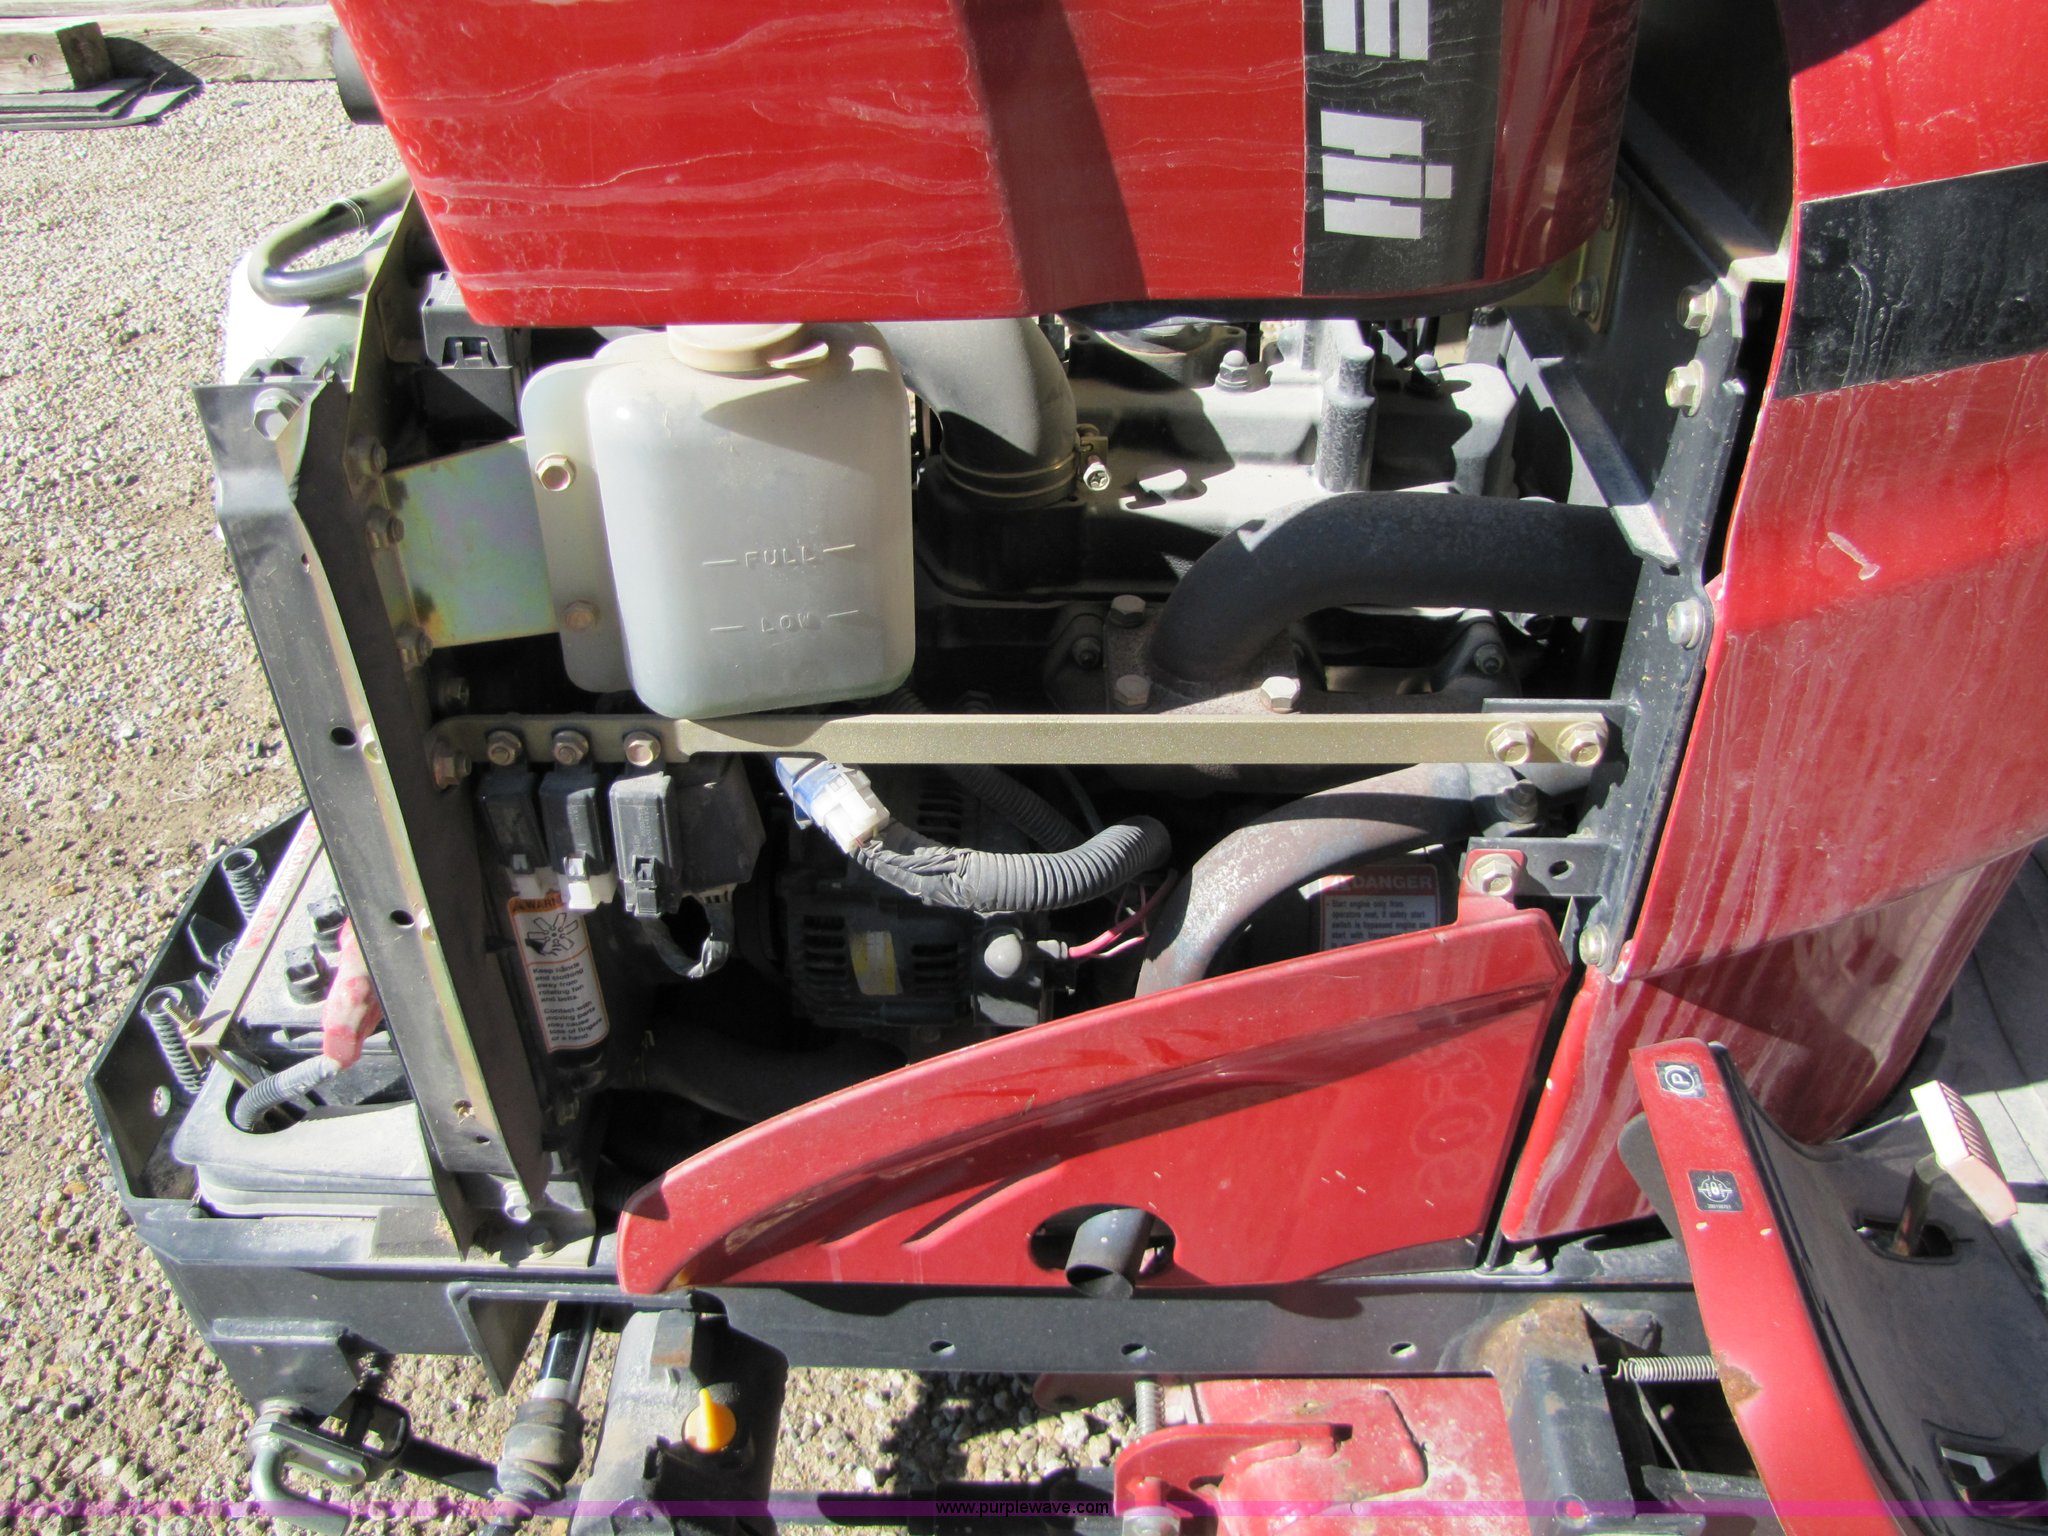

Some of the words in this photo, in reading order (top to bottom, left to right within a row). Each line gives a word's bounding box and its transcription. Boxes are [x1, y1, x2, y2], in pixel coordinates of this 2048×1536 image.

[744, 545, 817, 568] FULL
[761, 612, 813, 633] LOW
[1352, 875, 1432, 888] DANGER
[533, 967, 554, 975] Keep
[537, 982, 557, 990] away
[559, 979, 578, 988] from
[539, 989, 570, 997] rotating
[571, 984, 584, 993] fan
[577, 1007, 596, 1020] parts
[566, 1018, 590, 1028] cause
